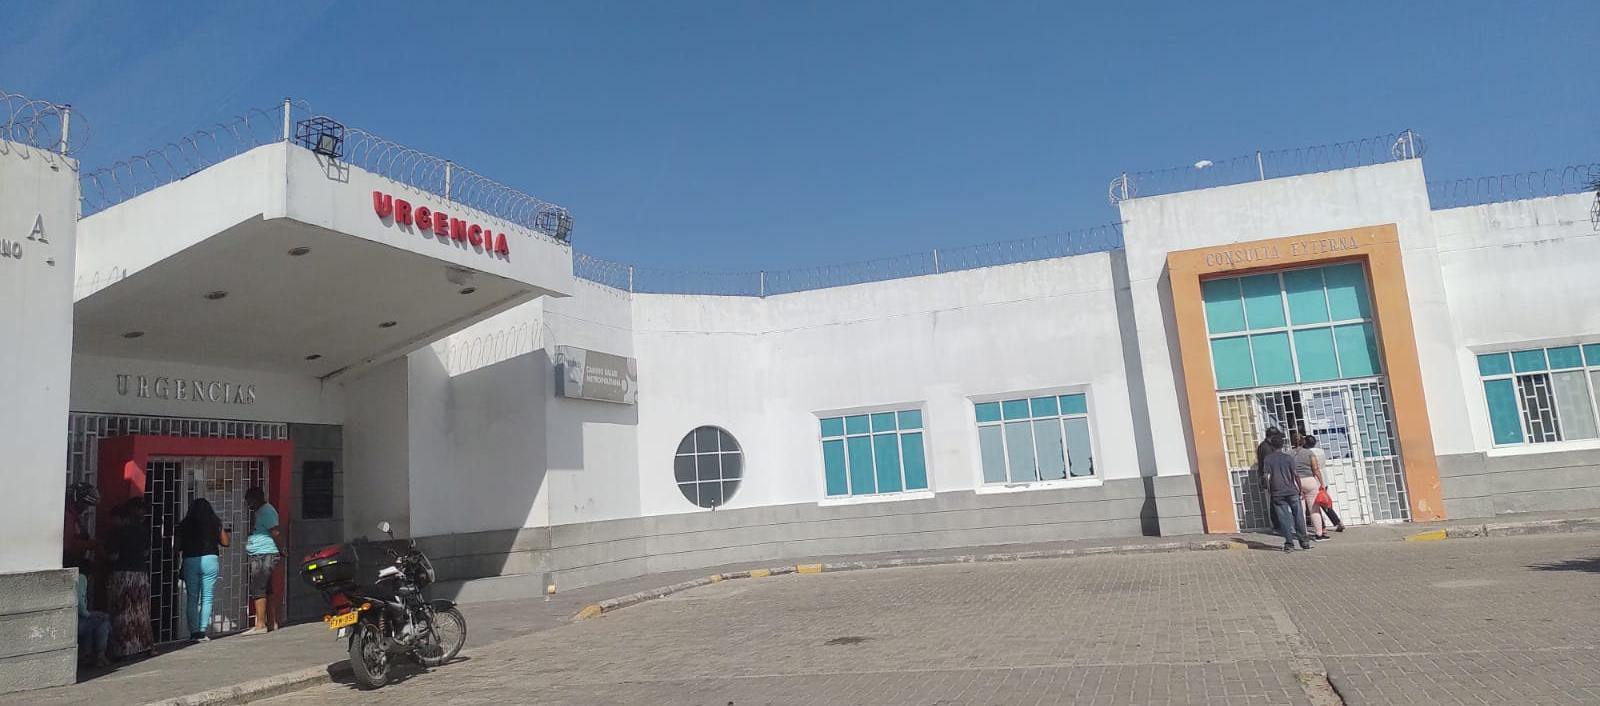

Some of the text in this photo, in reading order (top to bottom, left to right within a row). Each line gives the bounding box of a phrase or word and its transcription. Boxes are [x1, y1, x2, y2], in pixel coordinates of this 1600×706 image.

[373, 191, 509, 255] URGENCIA
[0, 238, 23, 260] NO
[116, 374, 257, 405] URGENCIAS
